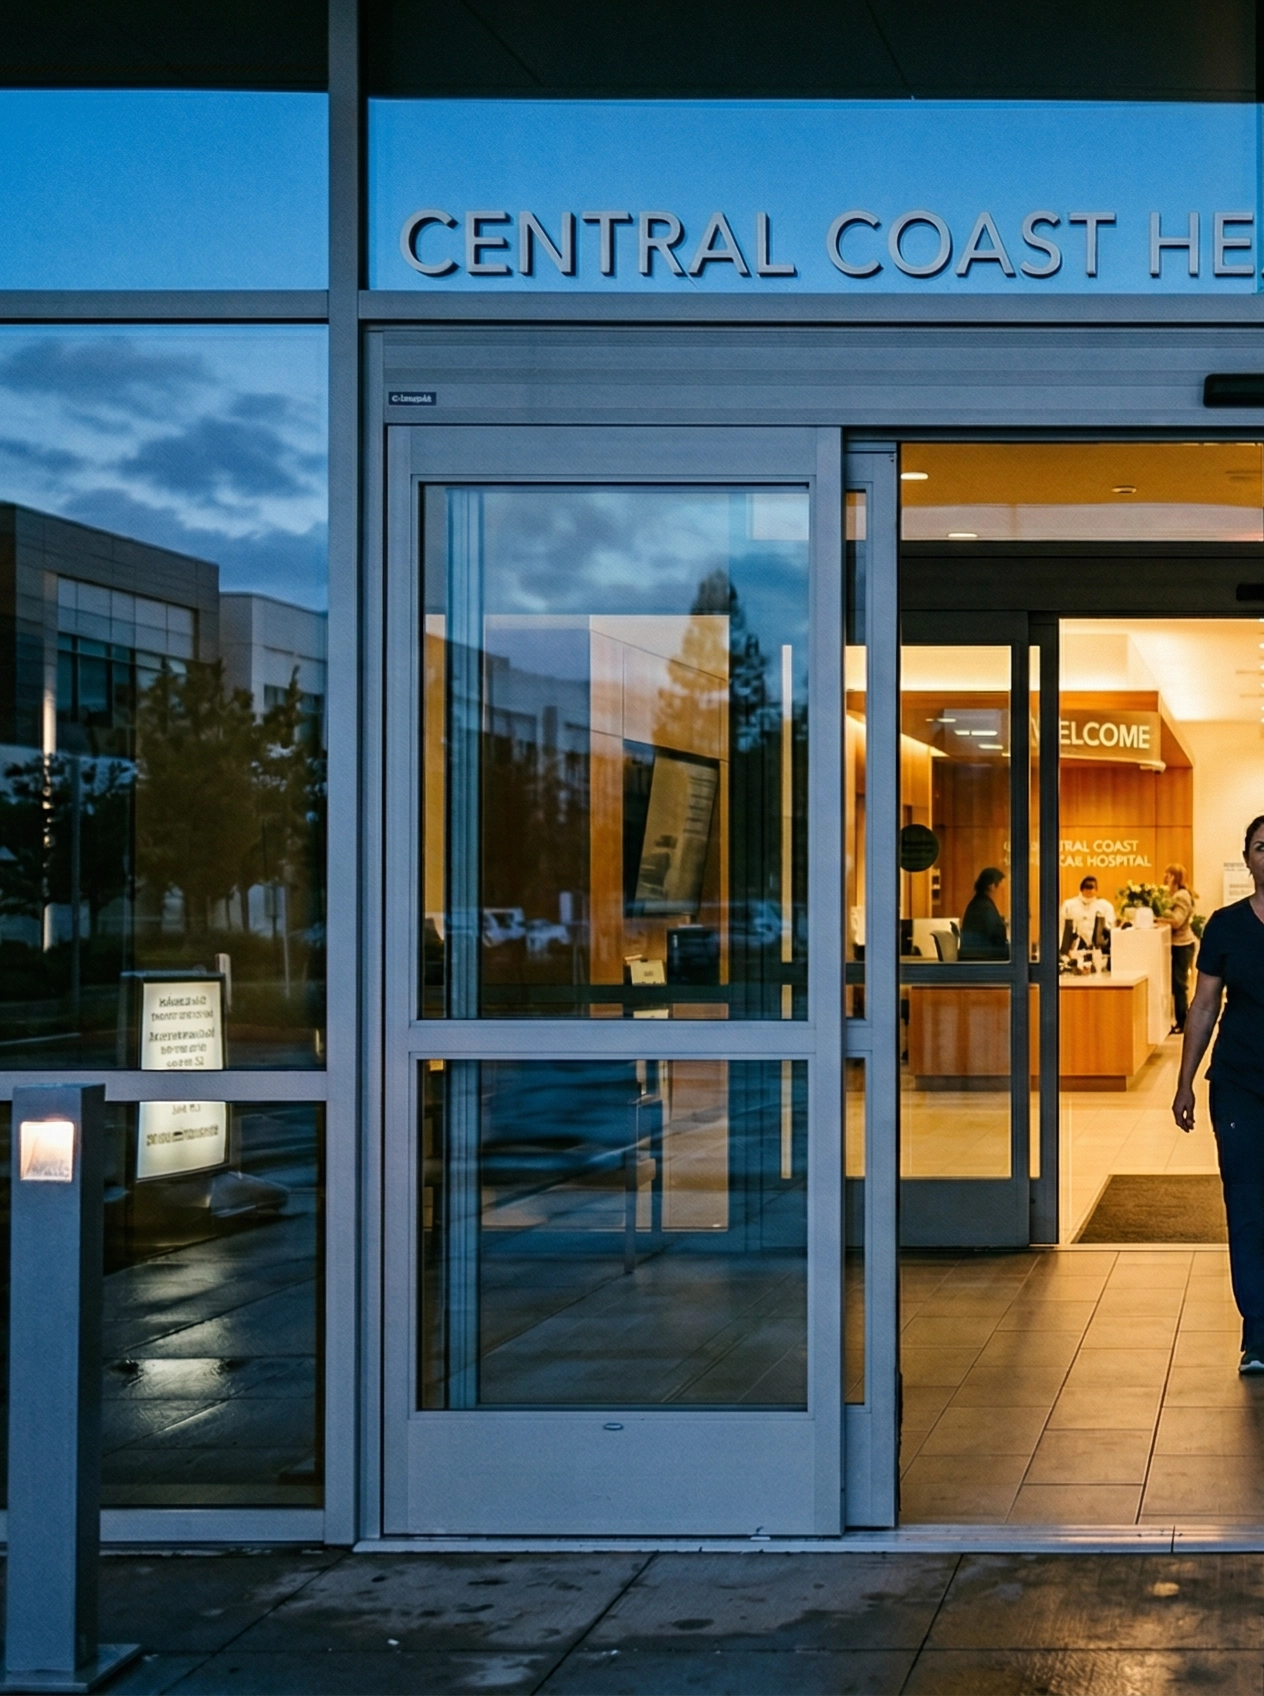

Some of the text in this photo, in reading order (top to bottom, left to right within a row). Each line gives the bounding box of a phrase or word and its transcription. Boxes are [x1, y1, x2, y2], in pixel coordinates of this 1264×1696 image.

[401, 209, 798, 278] CENTRAL
[826, 209, 1117, 278] COAST
[1093, 840, 1139, 853] COAST
[1087, 855, 1151, 867] HOSPITAL
